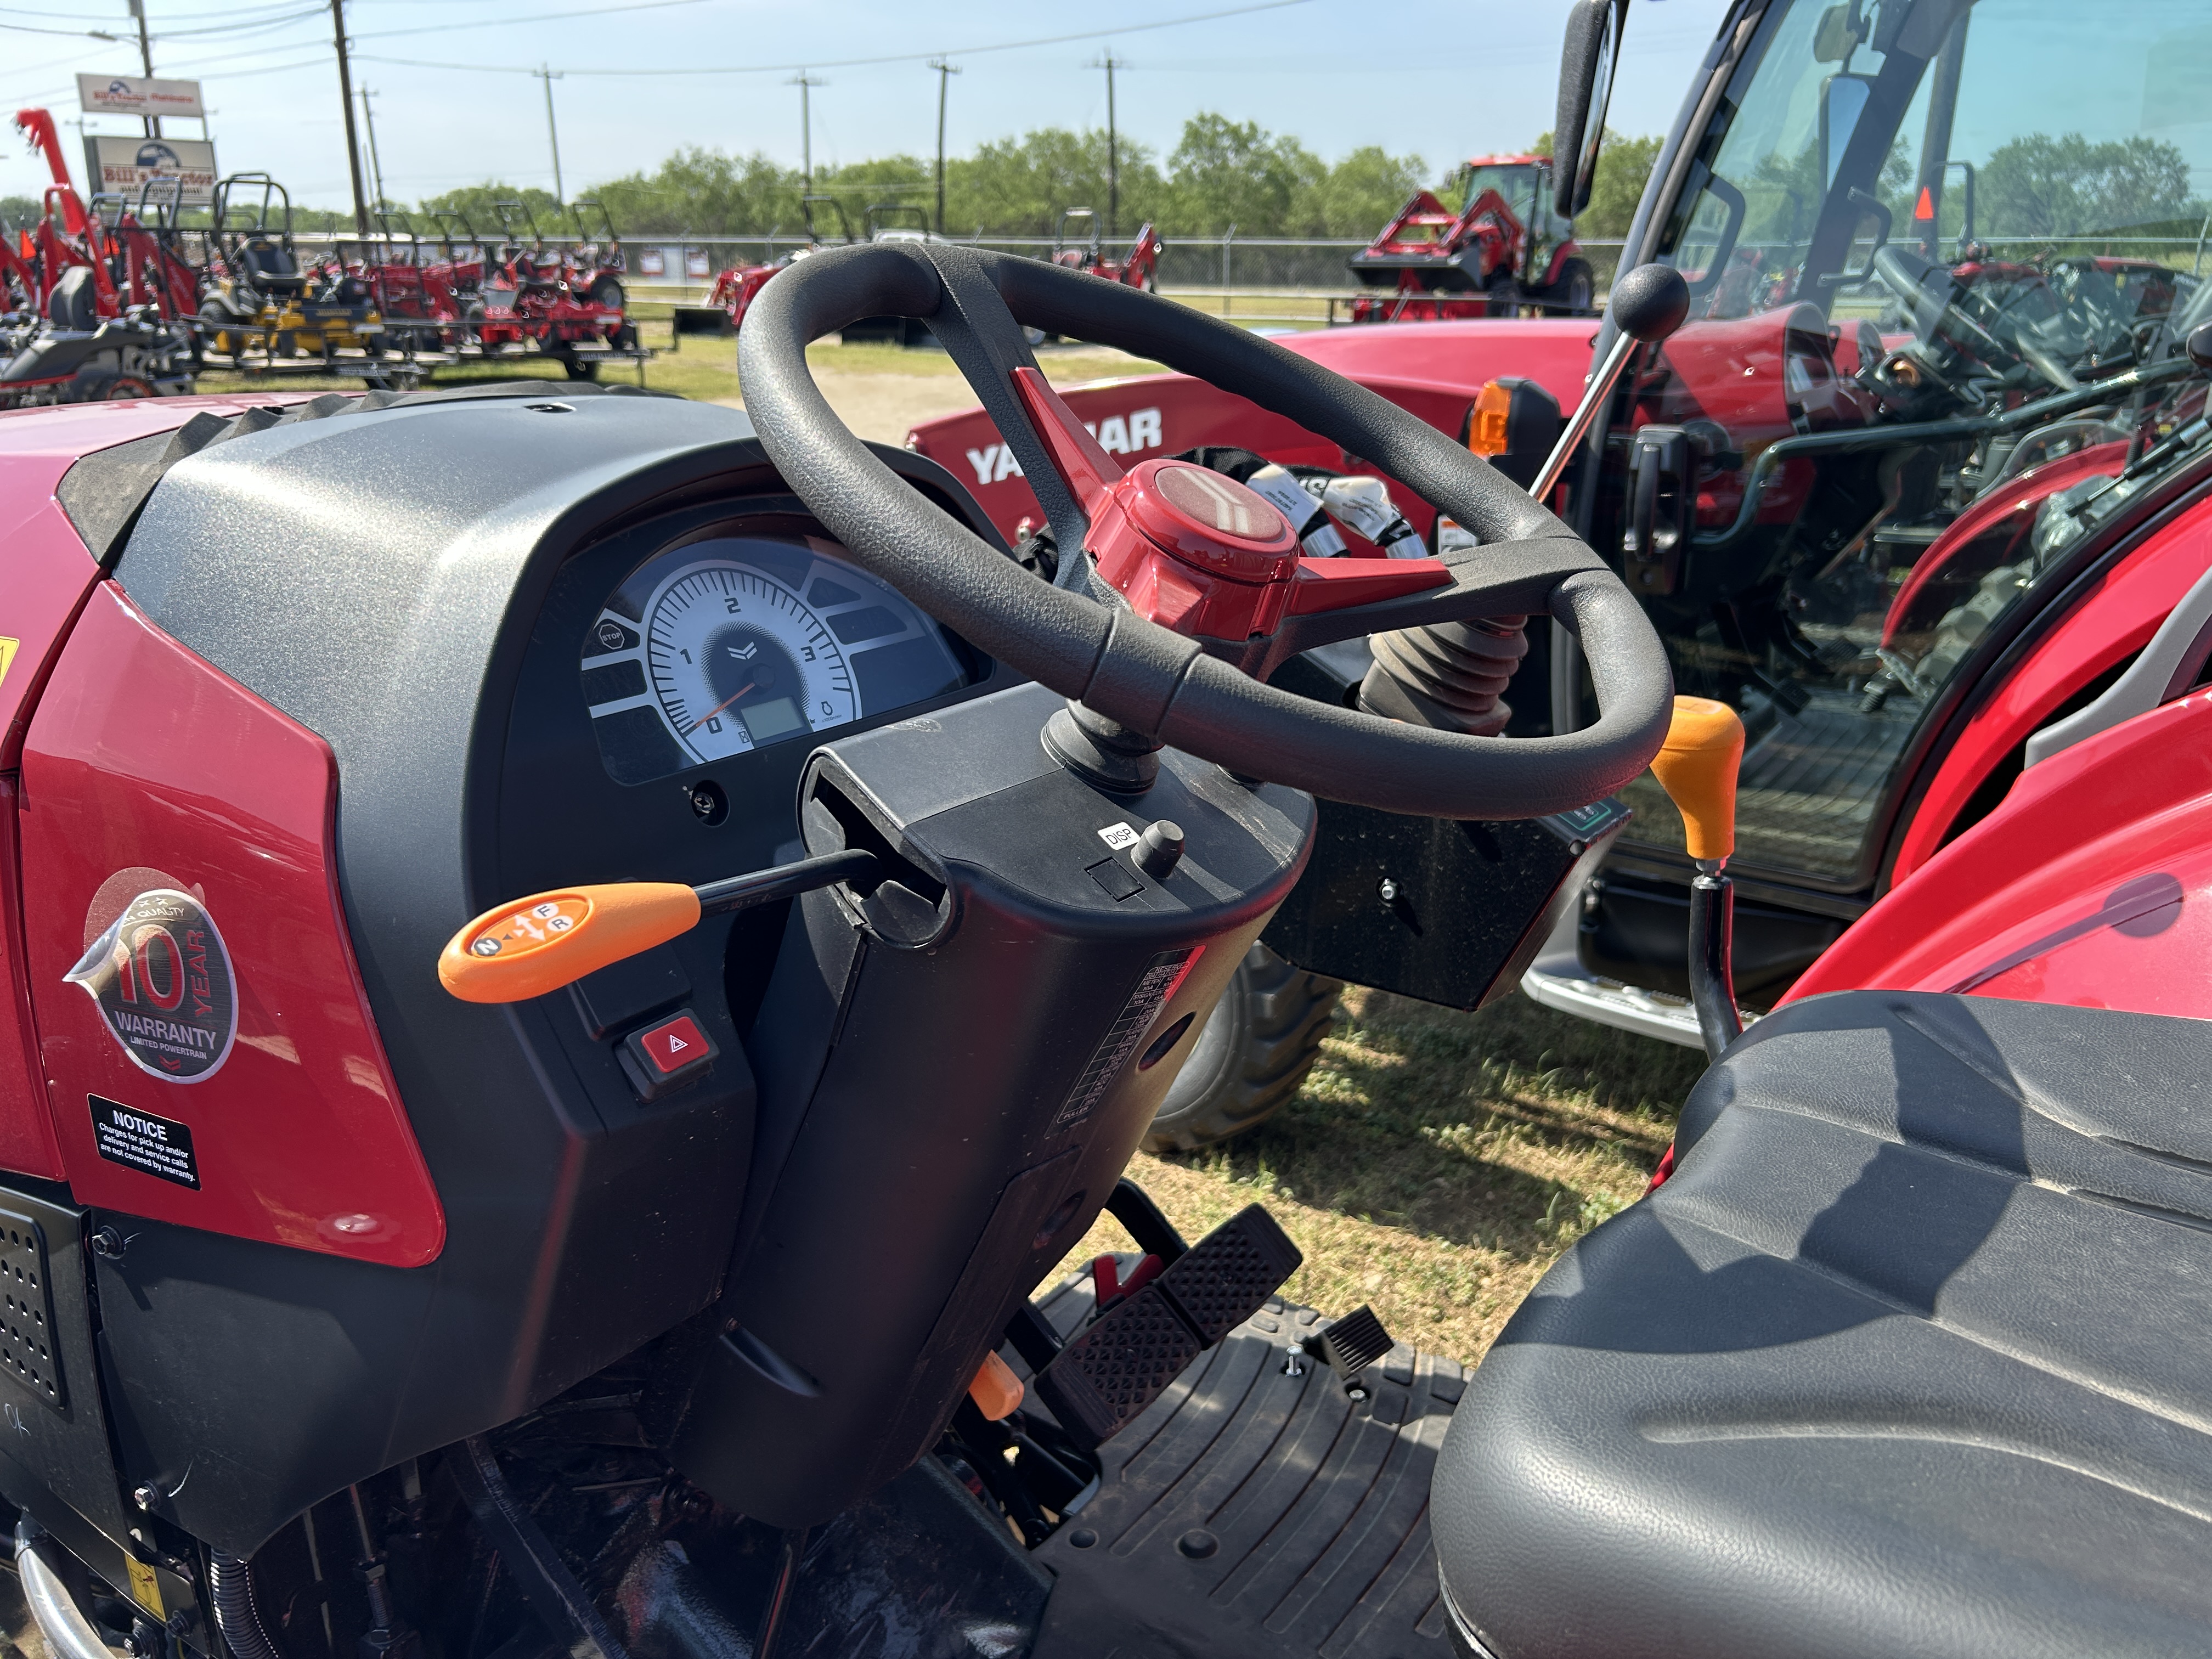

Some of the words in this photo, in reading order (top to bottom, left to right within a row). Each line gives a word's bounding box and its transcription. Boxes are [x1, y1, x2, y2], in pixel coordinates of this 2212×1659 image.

[966, 407, 1163, 485] YAAR
[724, 597, 742, 614] 2
[602, 632, 621, 641] STOP
[680, 648, 692, 664] 1
[800, 646, 816, 662] 3
[706, 716, 723, 734] 0
[1105, 828, 1131, 844] DISP
[138, 907, 184, 917] QUALITY
[537, 905, 550, 917] F
[551, 918, 569, 929] R
[477, 939, 499, 954] N
[112, 924, 185, 1012] 10
[187, 929, 213, 1017] YEAR
[115, 1011, 217, 1049] WARRANTY
[130, 1036, 158, 1049] LIMITED
[160, 1043, 207, 1060] POWERTRAIN
[113, 1110, 168, 1141] NOTICE
[99, 1122, 127, 1138] Charges
[128, 1132, 138, 1142] for
[139, 1137, 154, 1148] pick
[155, 1143, 165, 1152] up
[166, 1146, 188, 1159] and/or
[103, 1135, 129, 1150] delivery
[131, 1144, 143, 1154] and
[145, 1149, 170, 1163] service
[172, 1158, 188, 1169] calls
[100, 1143, 111, 1152] are
[112, 1148, 125, 1157] not
[125, 1152, 152, 1166] covered
[153, 1160, 162, 1171] by
[163, 1165, 196, 1181] warranty.
